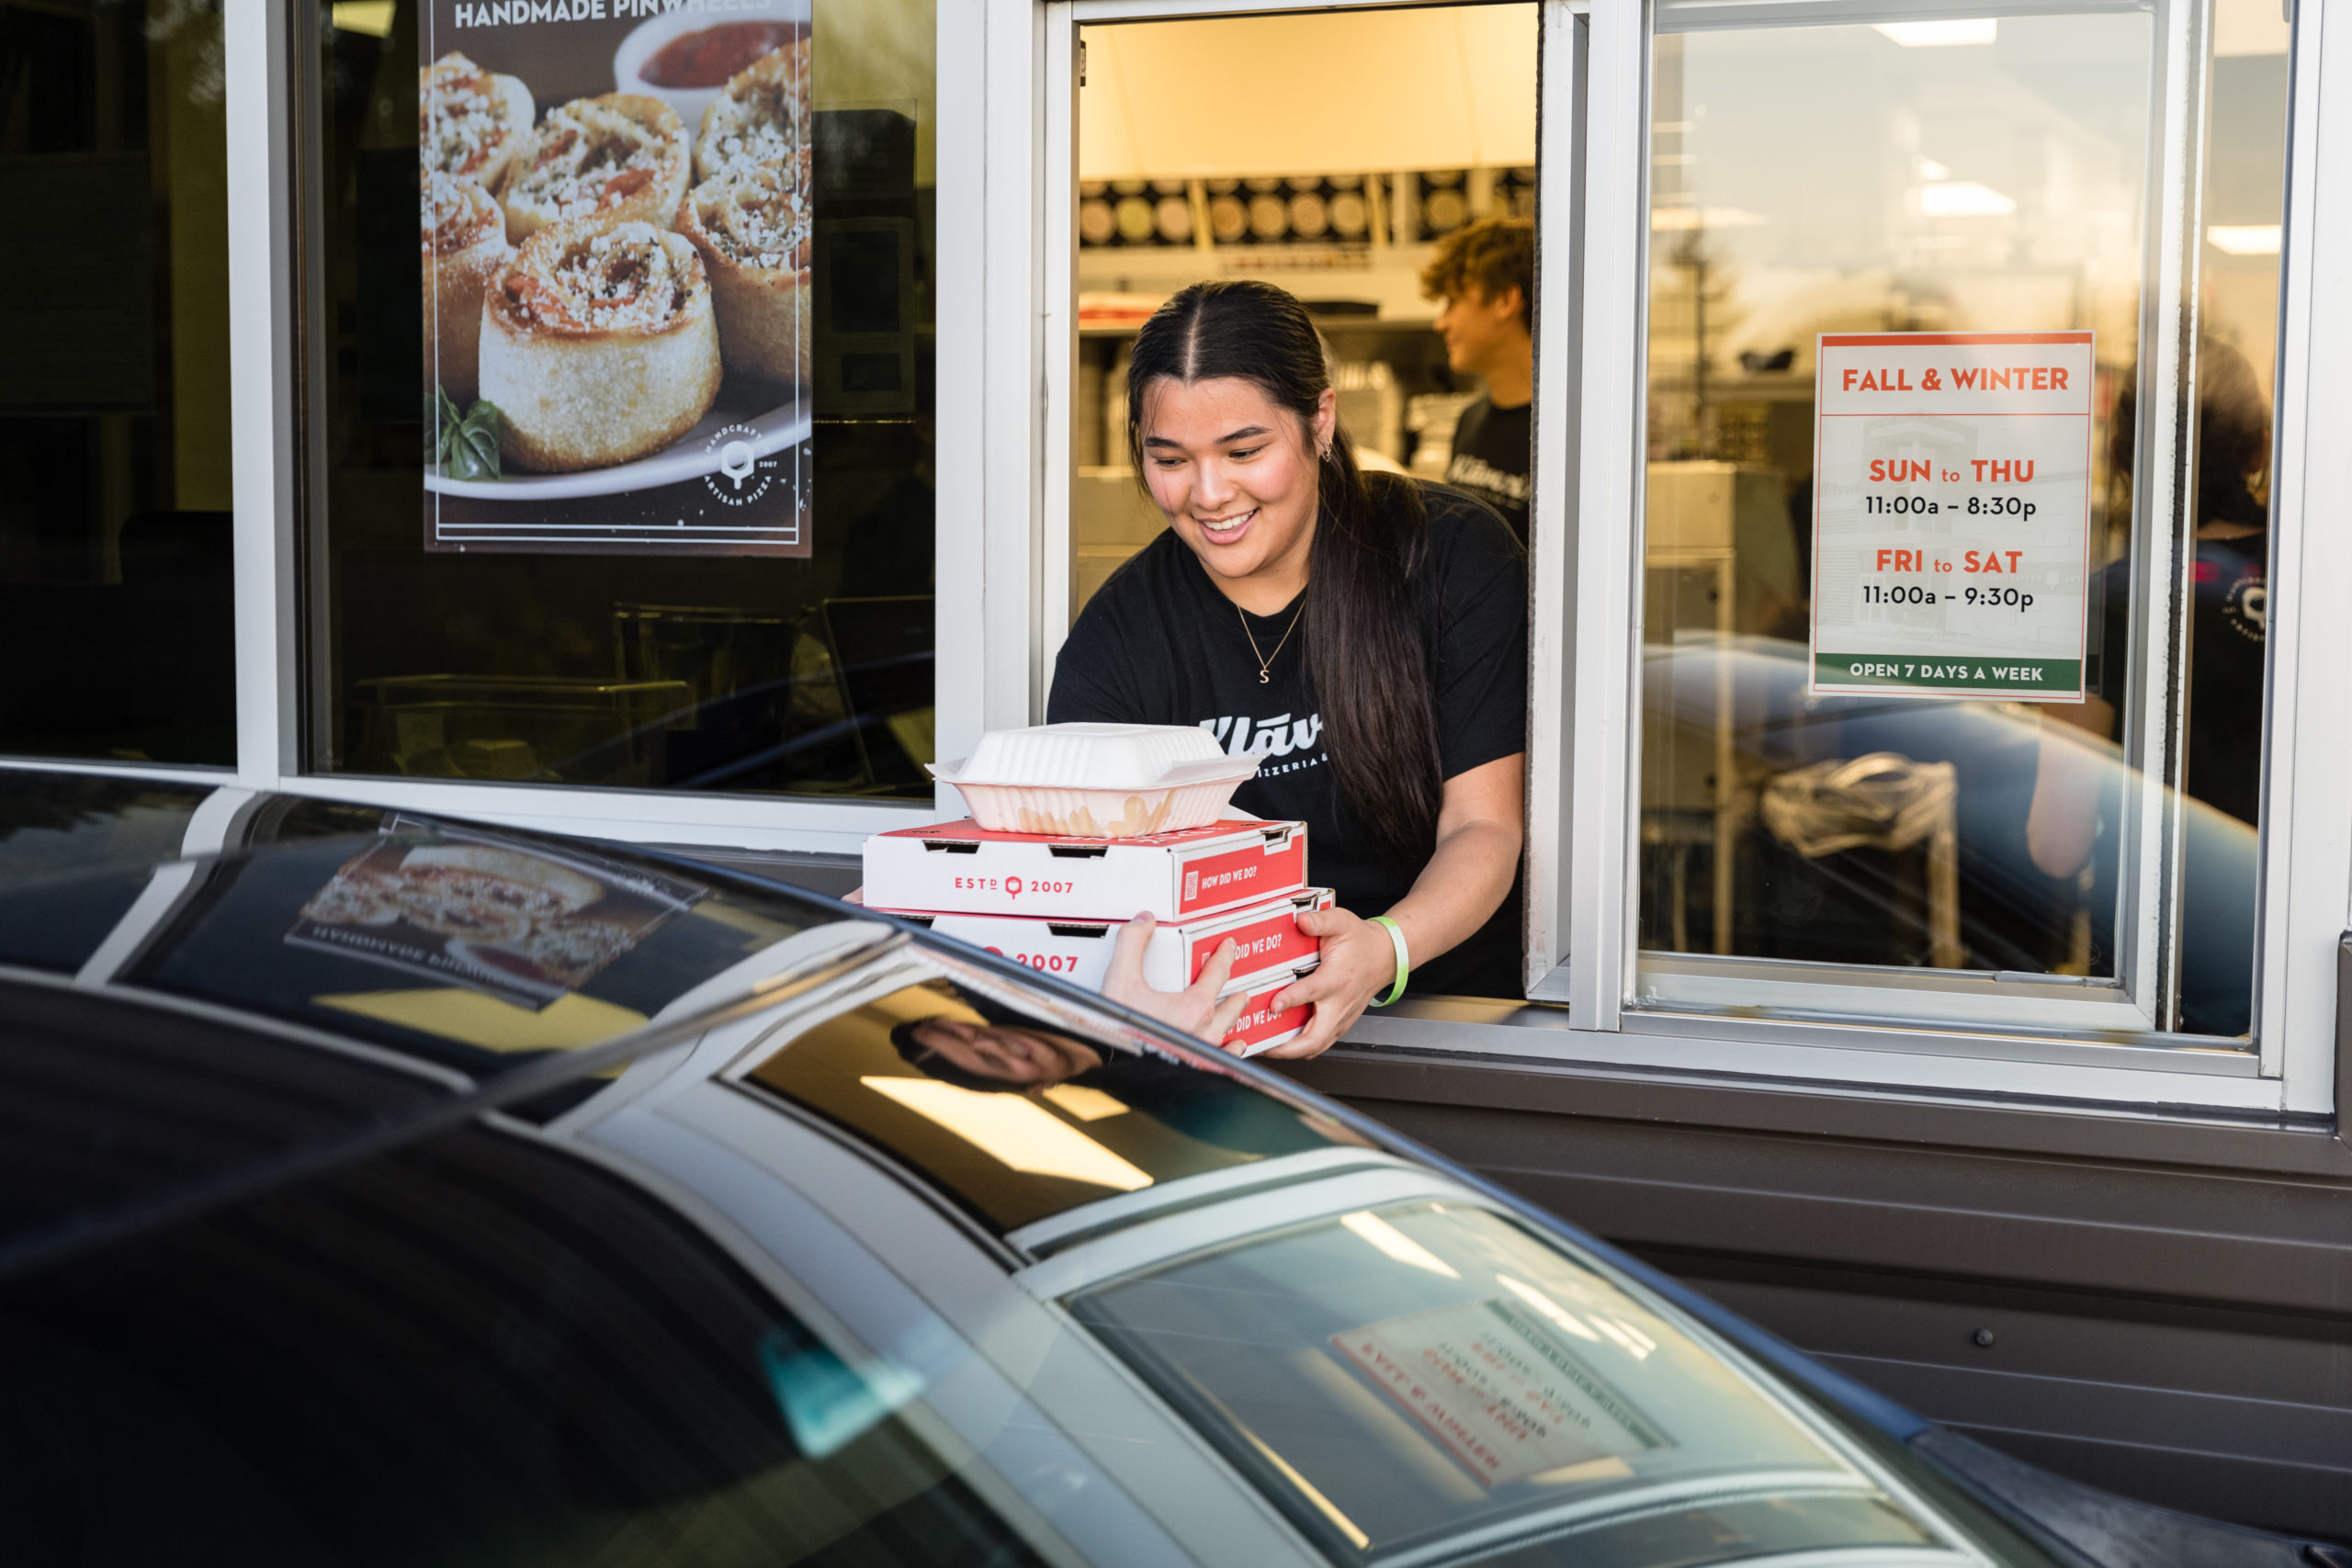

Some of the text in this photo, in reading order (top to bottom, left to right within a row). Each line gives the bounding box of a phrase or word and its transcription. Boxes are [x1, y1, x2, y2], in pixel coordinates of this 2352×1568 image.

[455, 0, 607, 28] HANDMADE
[1843, 367, 2069, 391] FALL & WINTER
[705, 423, 771, 454] HANDCRAFTD
[1869, 459, 2034, 483] SUN to THU
[704, 475, 773, 506] ARTISAN PIZZA
[1866, 496, 1939, 515] 11:00a
[1967, 496, 2037, 522] 8:30p
[1876, 549, 2023, 574] FRI to SAT
[1863, 585, 1937, 605] 11:00a
[1964, 587, 2034, 613] 9:30p
[1849, 663, 2043, 682] OPEN 7 DAYS A WEEK
[1258, 758, 1317, 778] IZZERIA
[1031, 880, 1073, 894] 2007
[1202, 865, 1257, 890] HOW DID WE DO?
[1235, 932, 1282, 961] DID WE DO?
[1016, 953, 1078, 972] 2007
[1236, 1014, 1251, 1032] DID
[1252, 1010, 1265, 1025] WE
